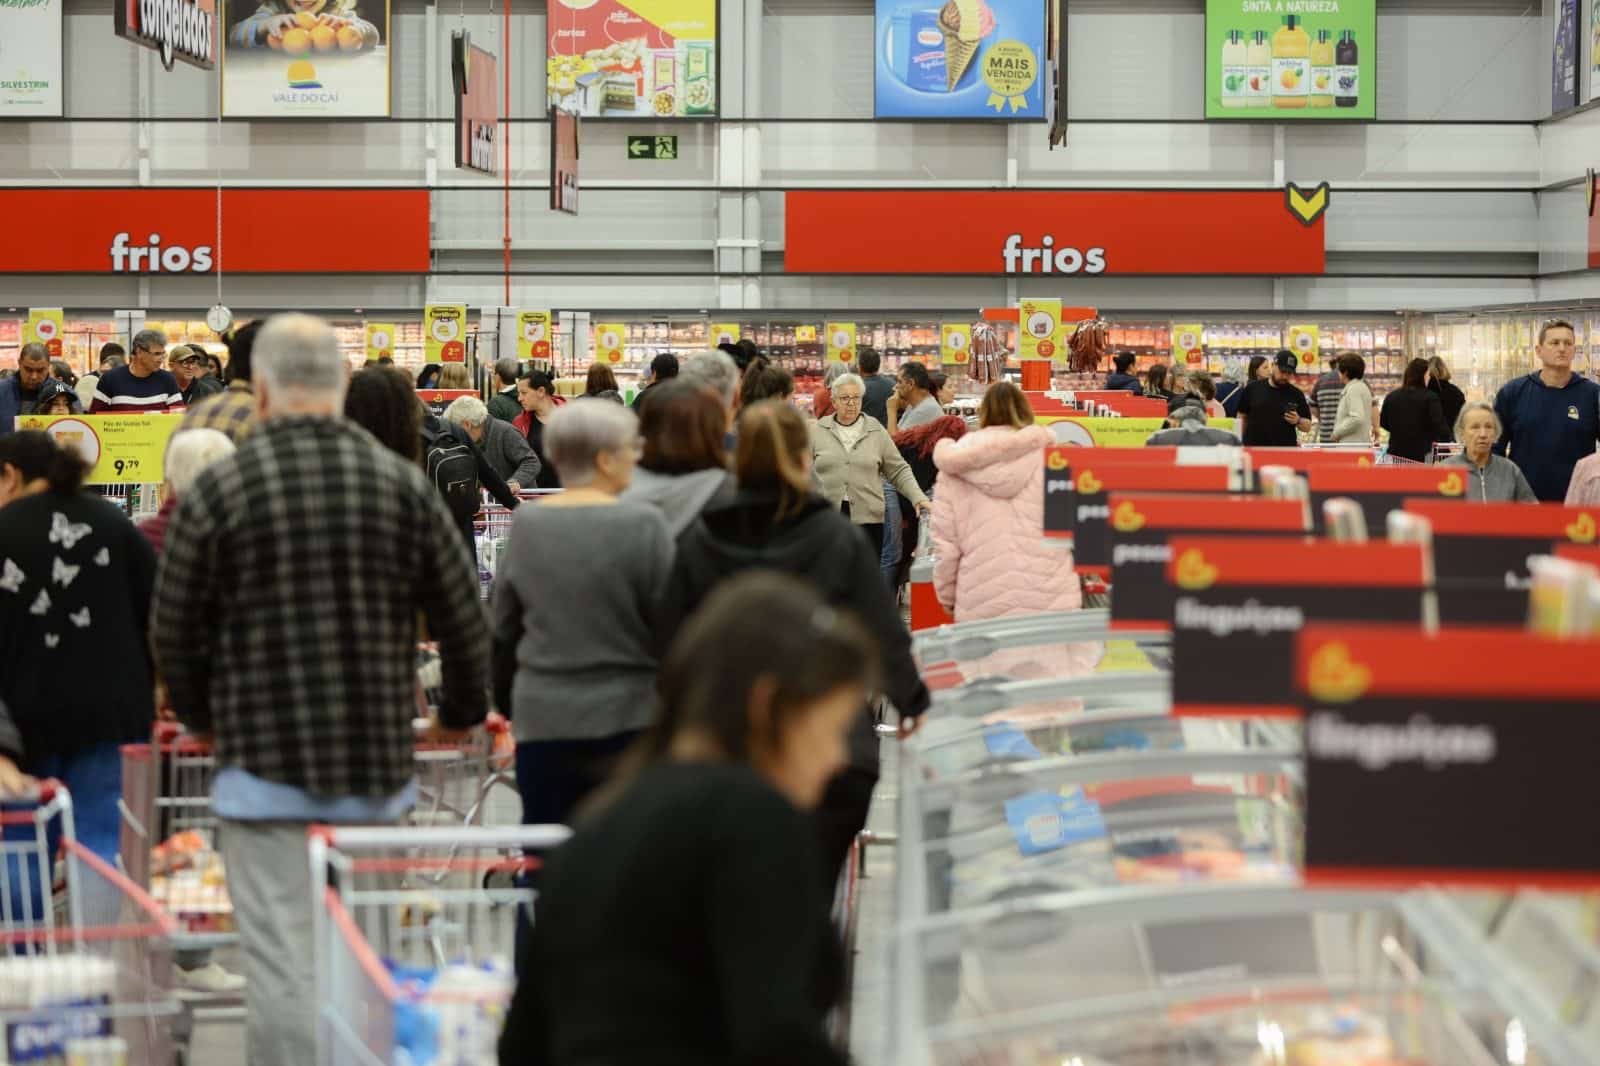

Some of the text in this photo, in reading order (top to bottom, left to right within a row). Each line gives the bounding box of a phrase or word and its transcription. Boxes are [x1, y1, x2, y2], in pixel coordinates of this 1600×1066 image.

[1242, 1, 1339, 13] SINTA A NATUREZA
[990, 57, 1029, 70] MAIS
[986, 69, 1031, 79] VENDIDA
[0, 80, 49, 89] SILVESTRIN
[272, 93, 298, 103] VALE
[300, 93, 318, 103] DO
[110, 232, 213, 272] frios
[1003, 234, 1106, 273] frios
[114, 460, 140, 476] 9,79
